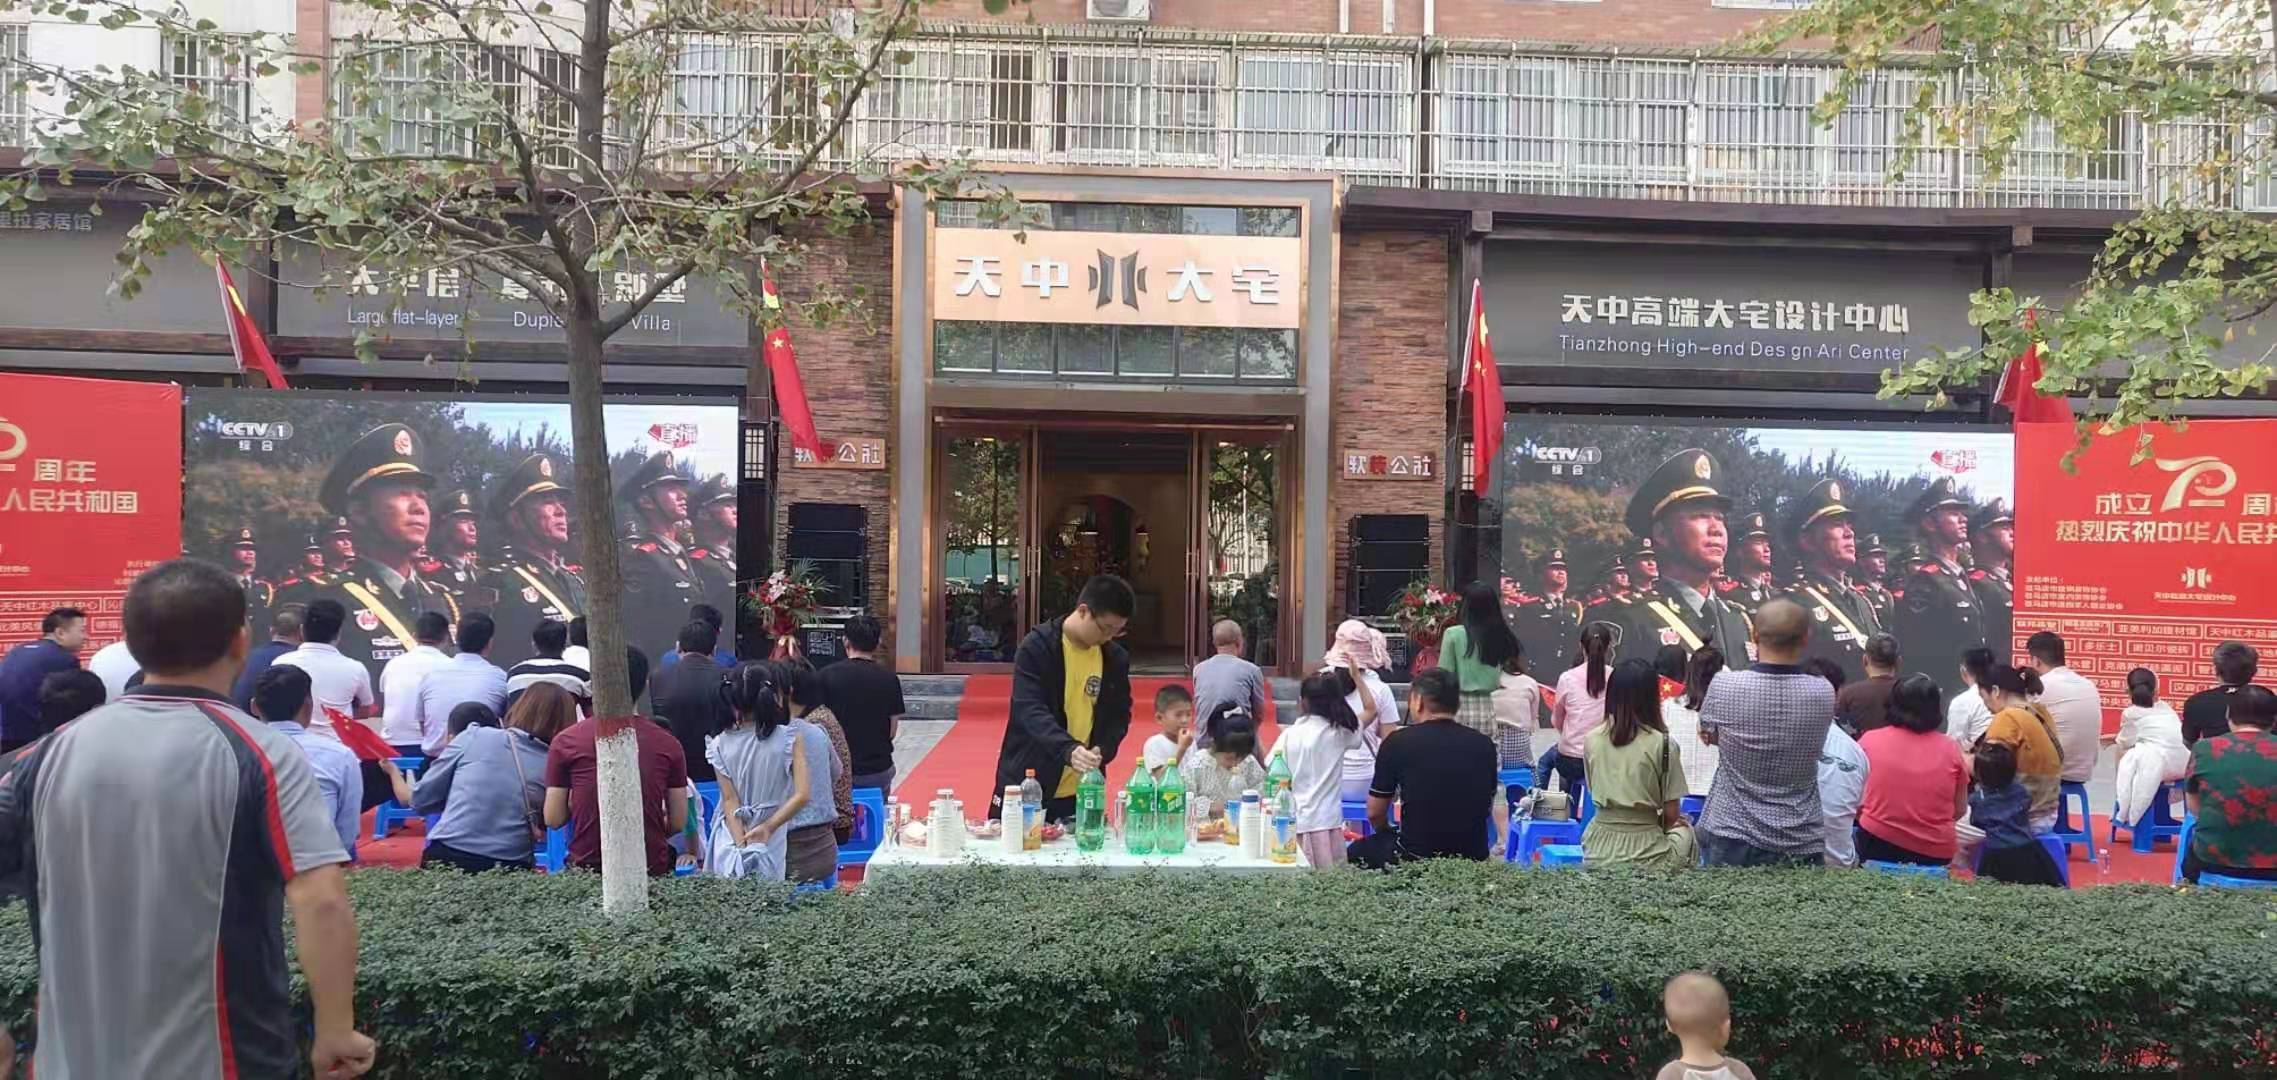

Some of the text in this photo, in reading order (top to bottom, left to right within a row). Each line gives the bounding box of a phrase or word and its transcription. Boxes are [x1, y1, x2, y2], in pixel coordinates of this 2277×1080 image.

[953, 255, 1280, 304] 天中 大宅
[631, 314, 671, 331] Villa
[1561, 294, 1909, 333] 天中高端大宅设计中心
[1560, 335, 1651, 356] Tianzhong
[1657, 338, 1744, 357] High-end
[1849, 343, 1911, 361] Center
[33, 459, 97, 483] 周年
[0, 488, 138, 514] 人民共和国
